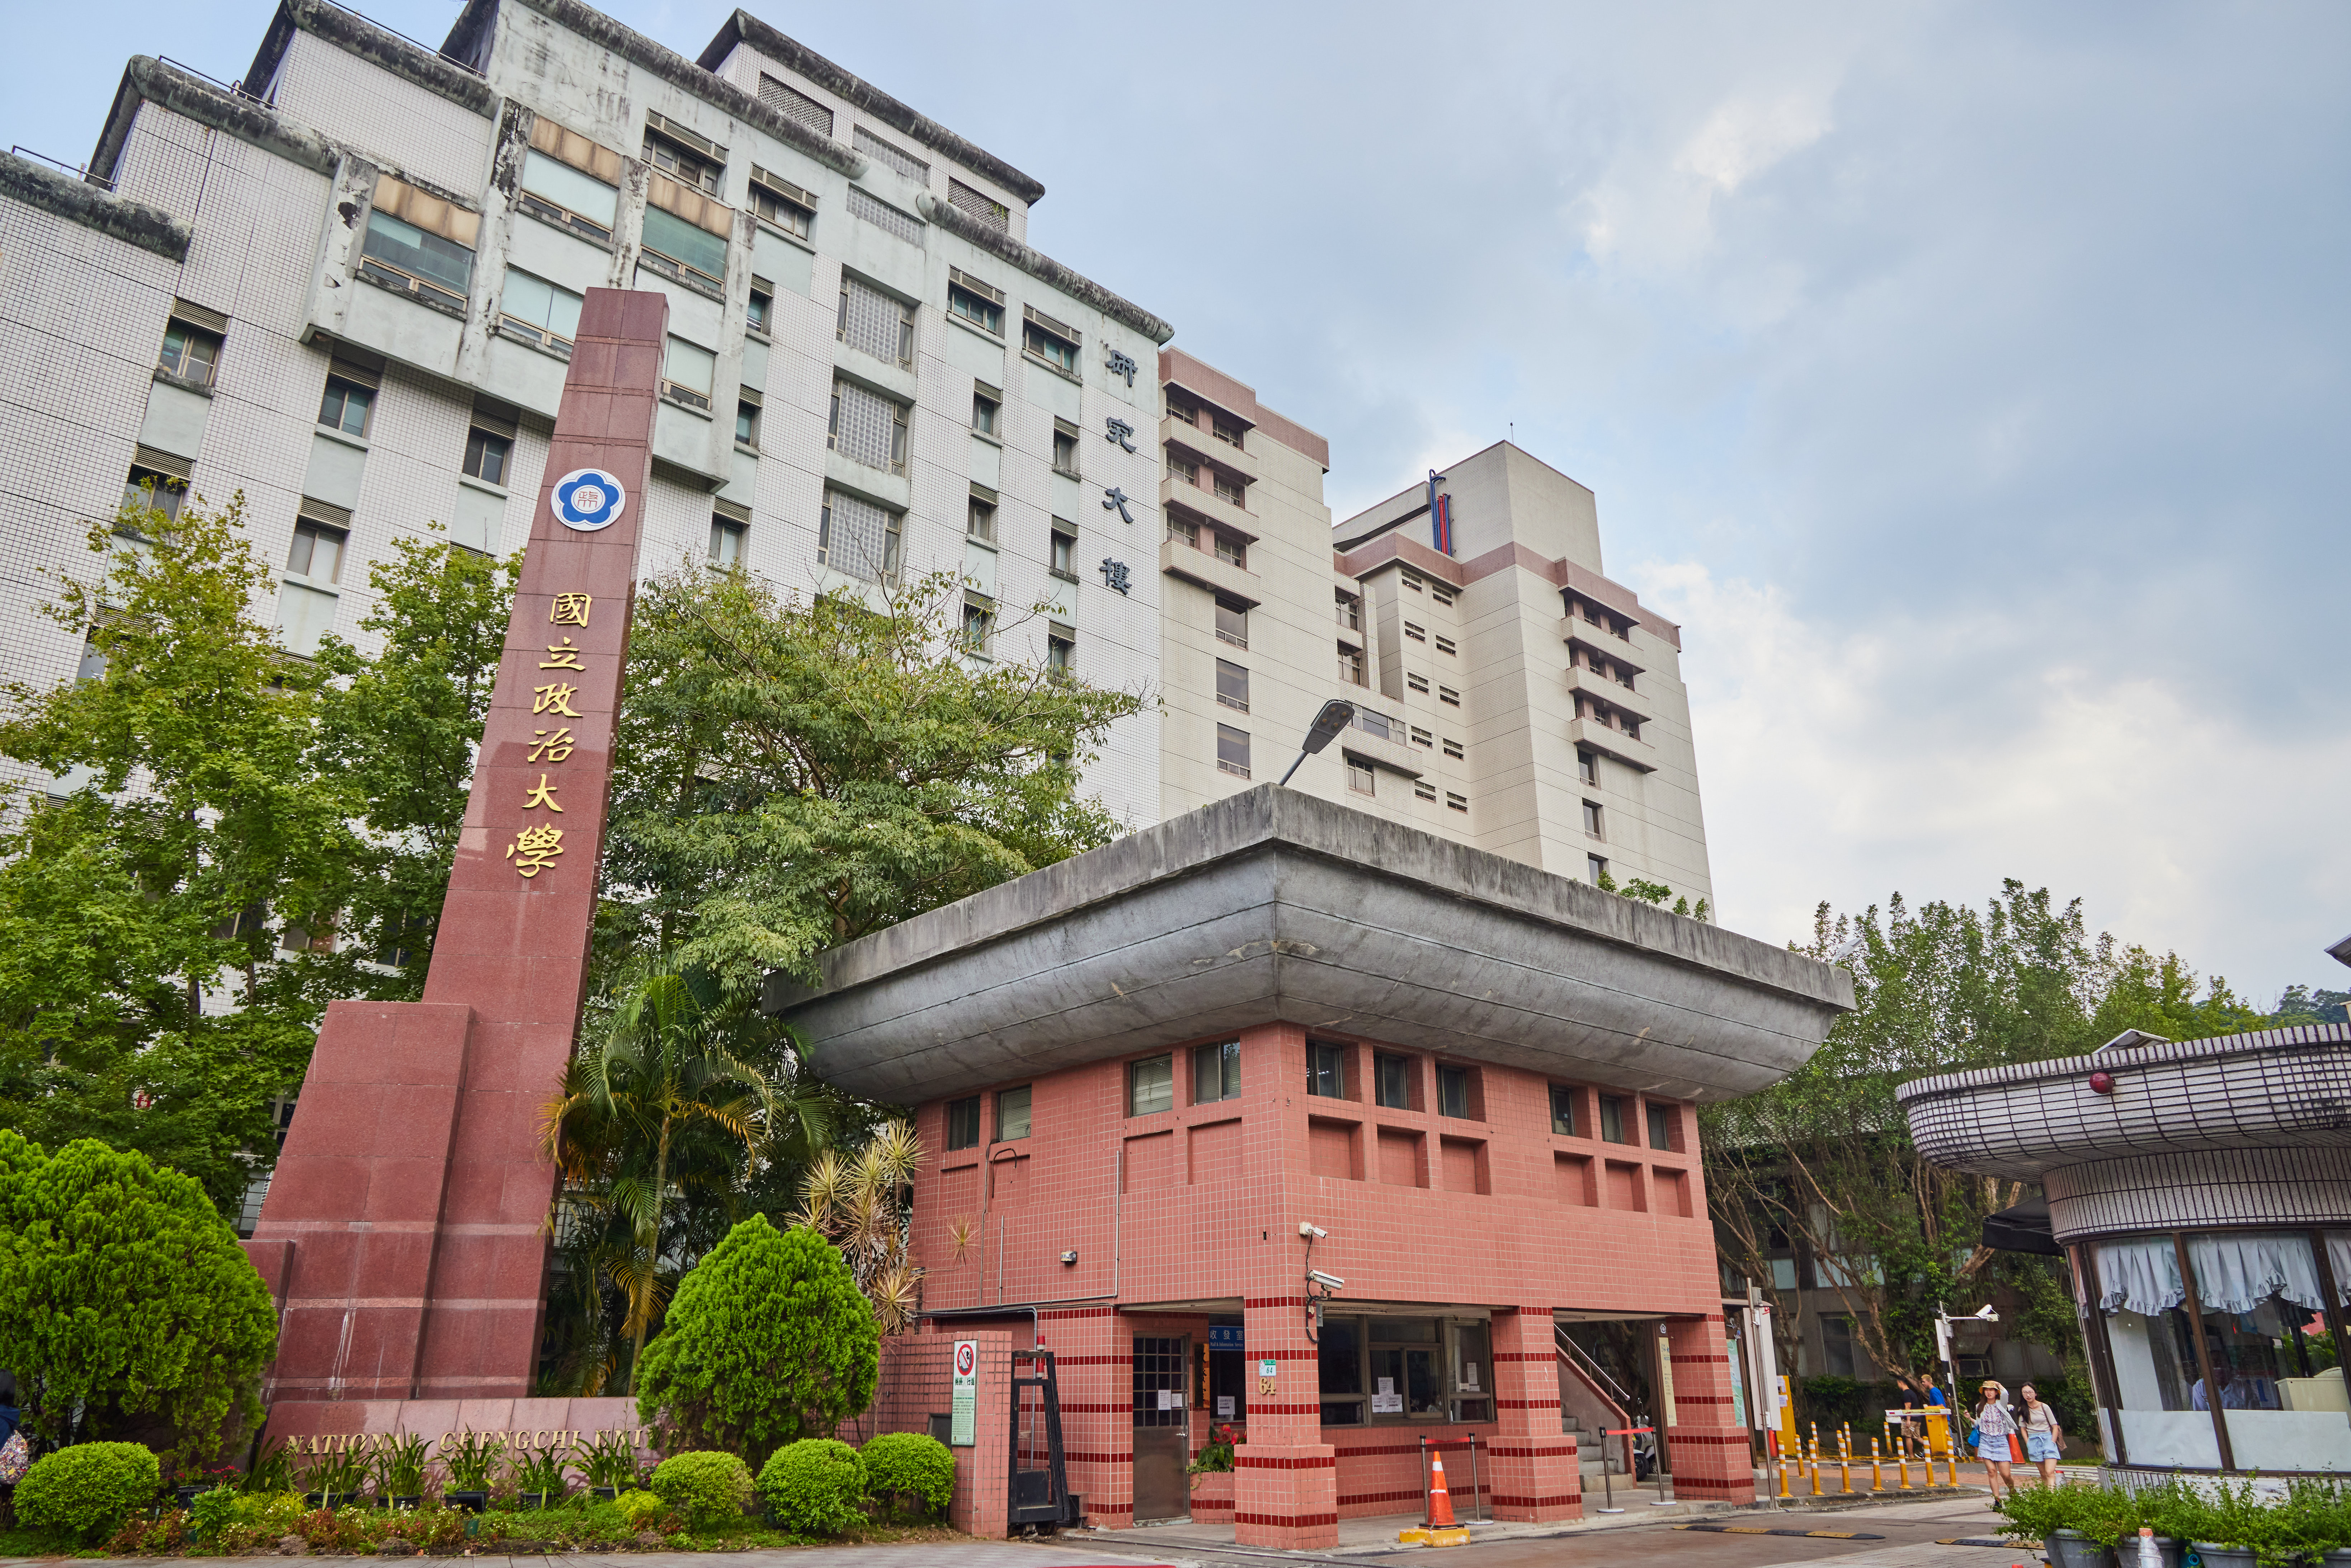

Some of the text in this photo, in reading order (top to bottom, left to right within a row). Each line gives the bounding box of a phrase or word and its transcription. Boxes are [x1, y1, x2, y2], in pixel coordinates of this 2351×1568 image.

[1099, 349, 1138, 595] 研究大樓
[506, 593, 592, 877] 國立政治大學
[1210, 1330, 1243, 1340] 收發室
[1259, 1377, 1276, 1394] 64
[439, 1430, 580, 1451] CHENGCHI
